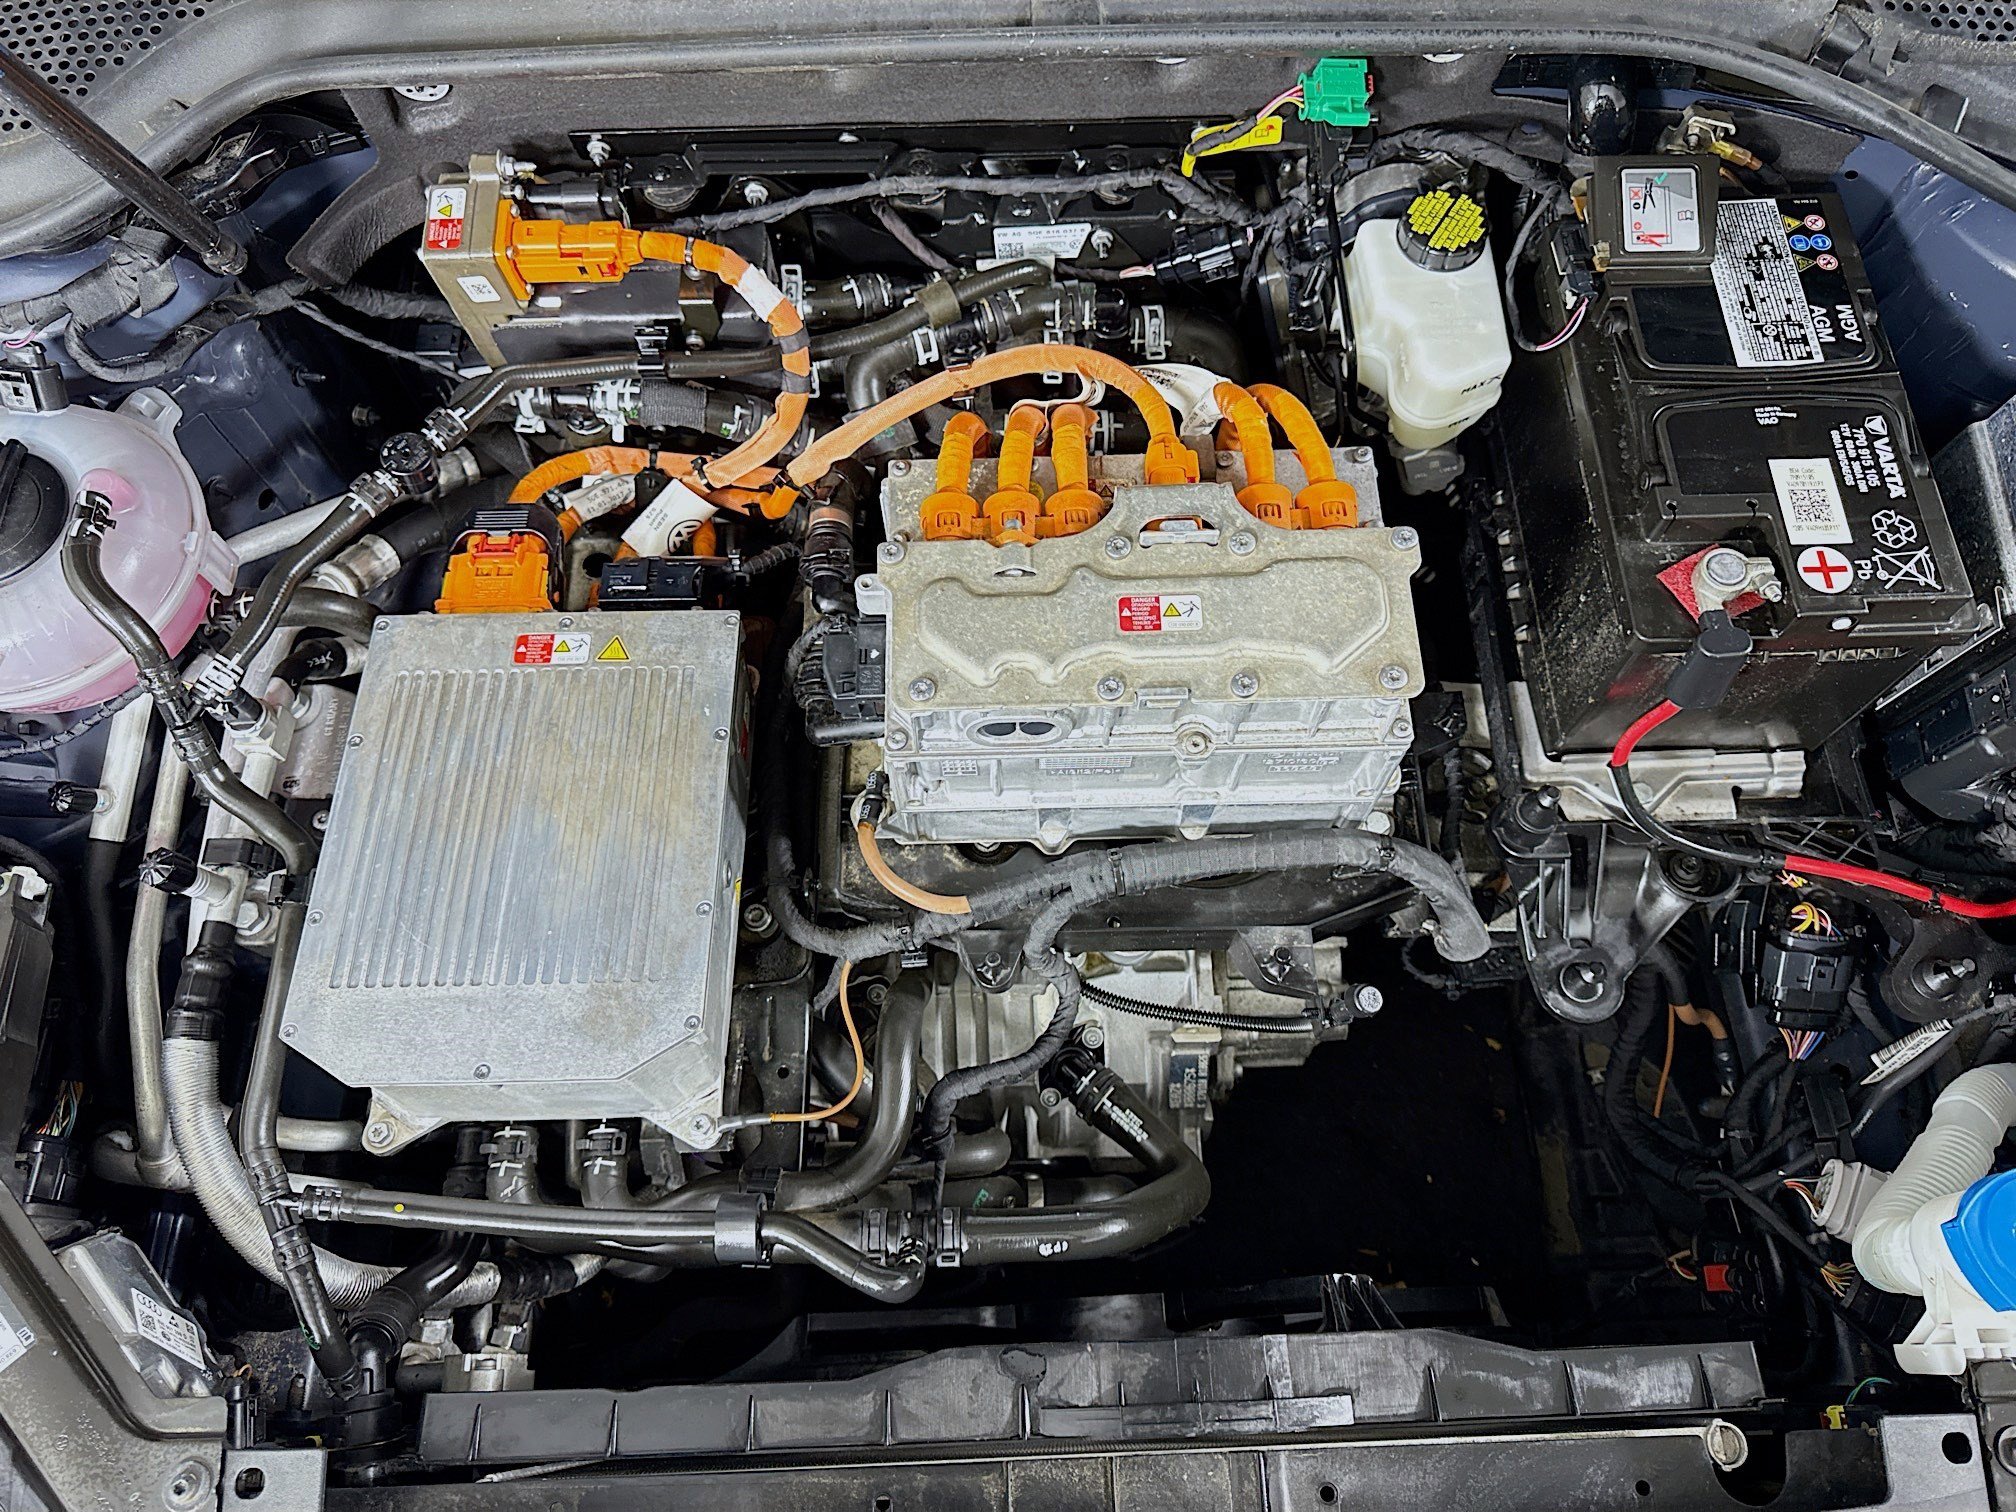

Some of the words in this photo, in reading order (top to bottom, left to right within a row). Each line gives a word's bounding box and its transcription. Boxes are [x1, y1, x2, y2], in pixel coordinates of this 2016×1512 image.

[1809, 305, 1836, 343] AGM
[1836, 304, 1863, 343] AGM
[1840, 423, 1850, 437] 12V
[1860, 448, 1874, 467] 915
[1867, 467, 1881, 487] 105
[1873, 437, 1905, 499] VARTA
[1854, 559, 1873, 580] Pb
